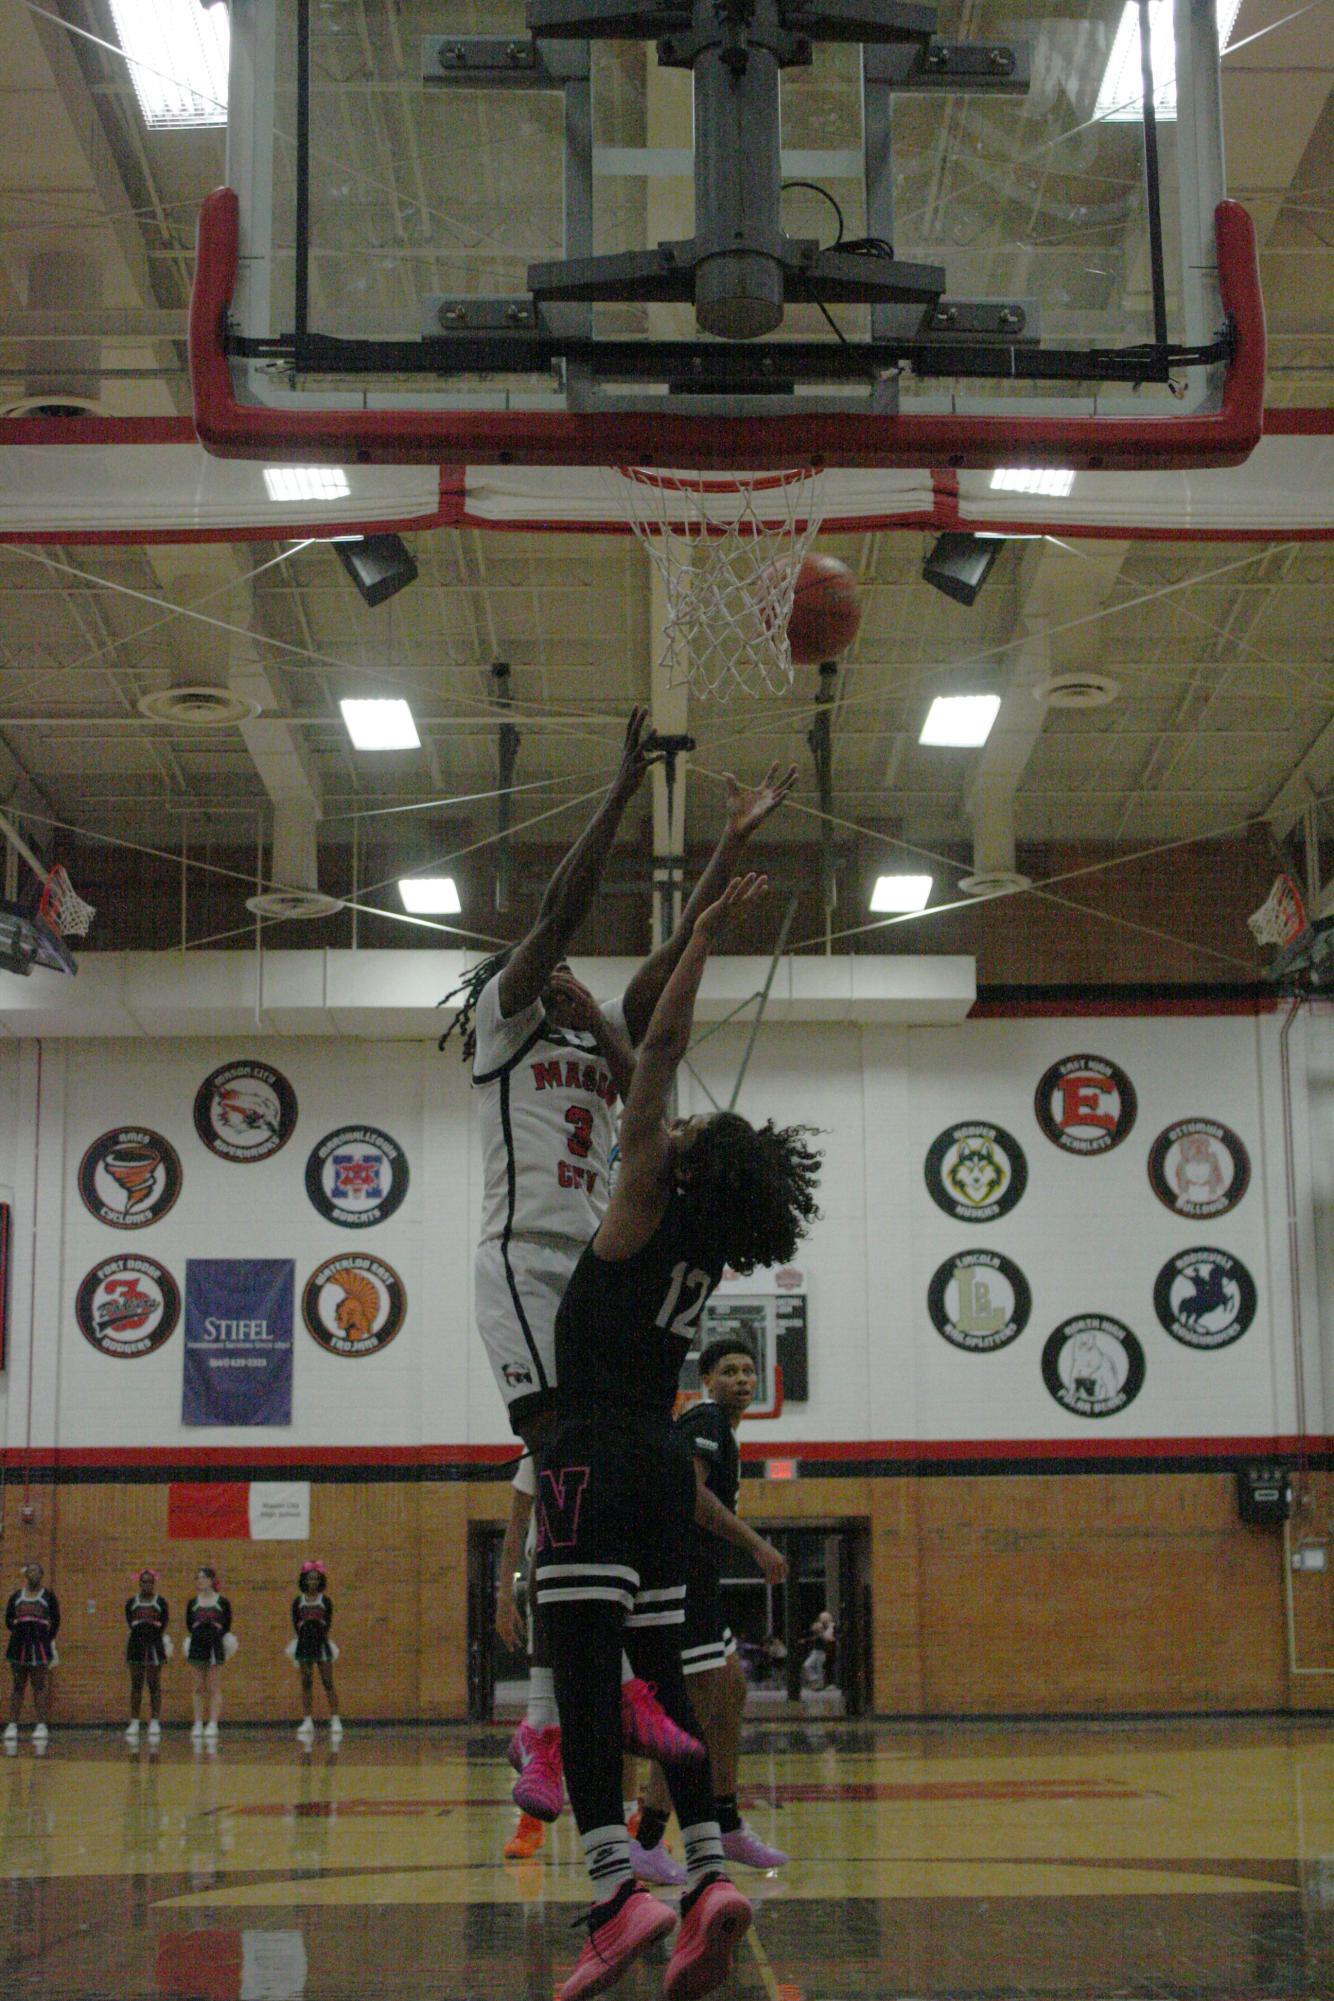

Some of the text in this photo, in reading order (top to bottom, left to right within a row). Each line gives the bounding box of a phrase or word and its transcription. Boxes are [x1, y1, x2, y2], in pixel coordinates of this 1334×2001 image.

[565, 1105, 593, 1158] 3
[1057, 1077, 1117, 1133] E
[654, 1261, 711, 1339] 12
[204, 1316, 274, 1340] STIFEL
